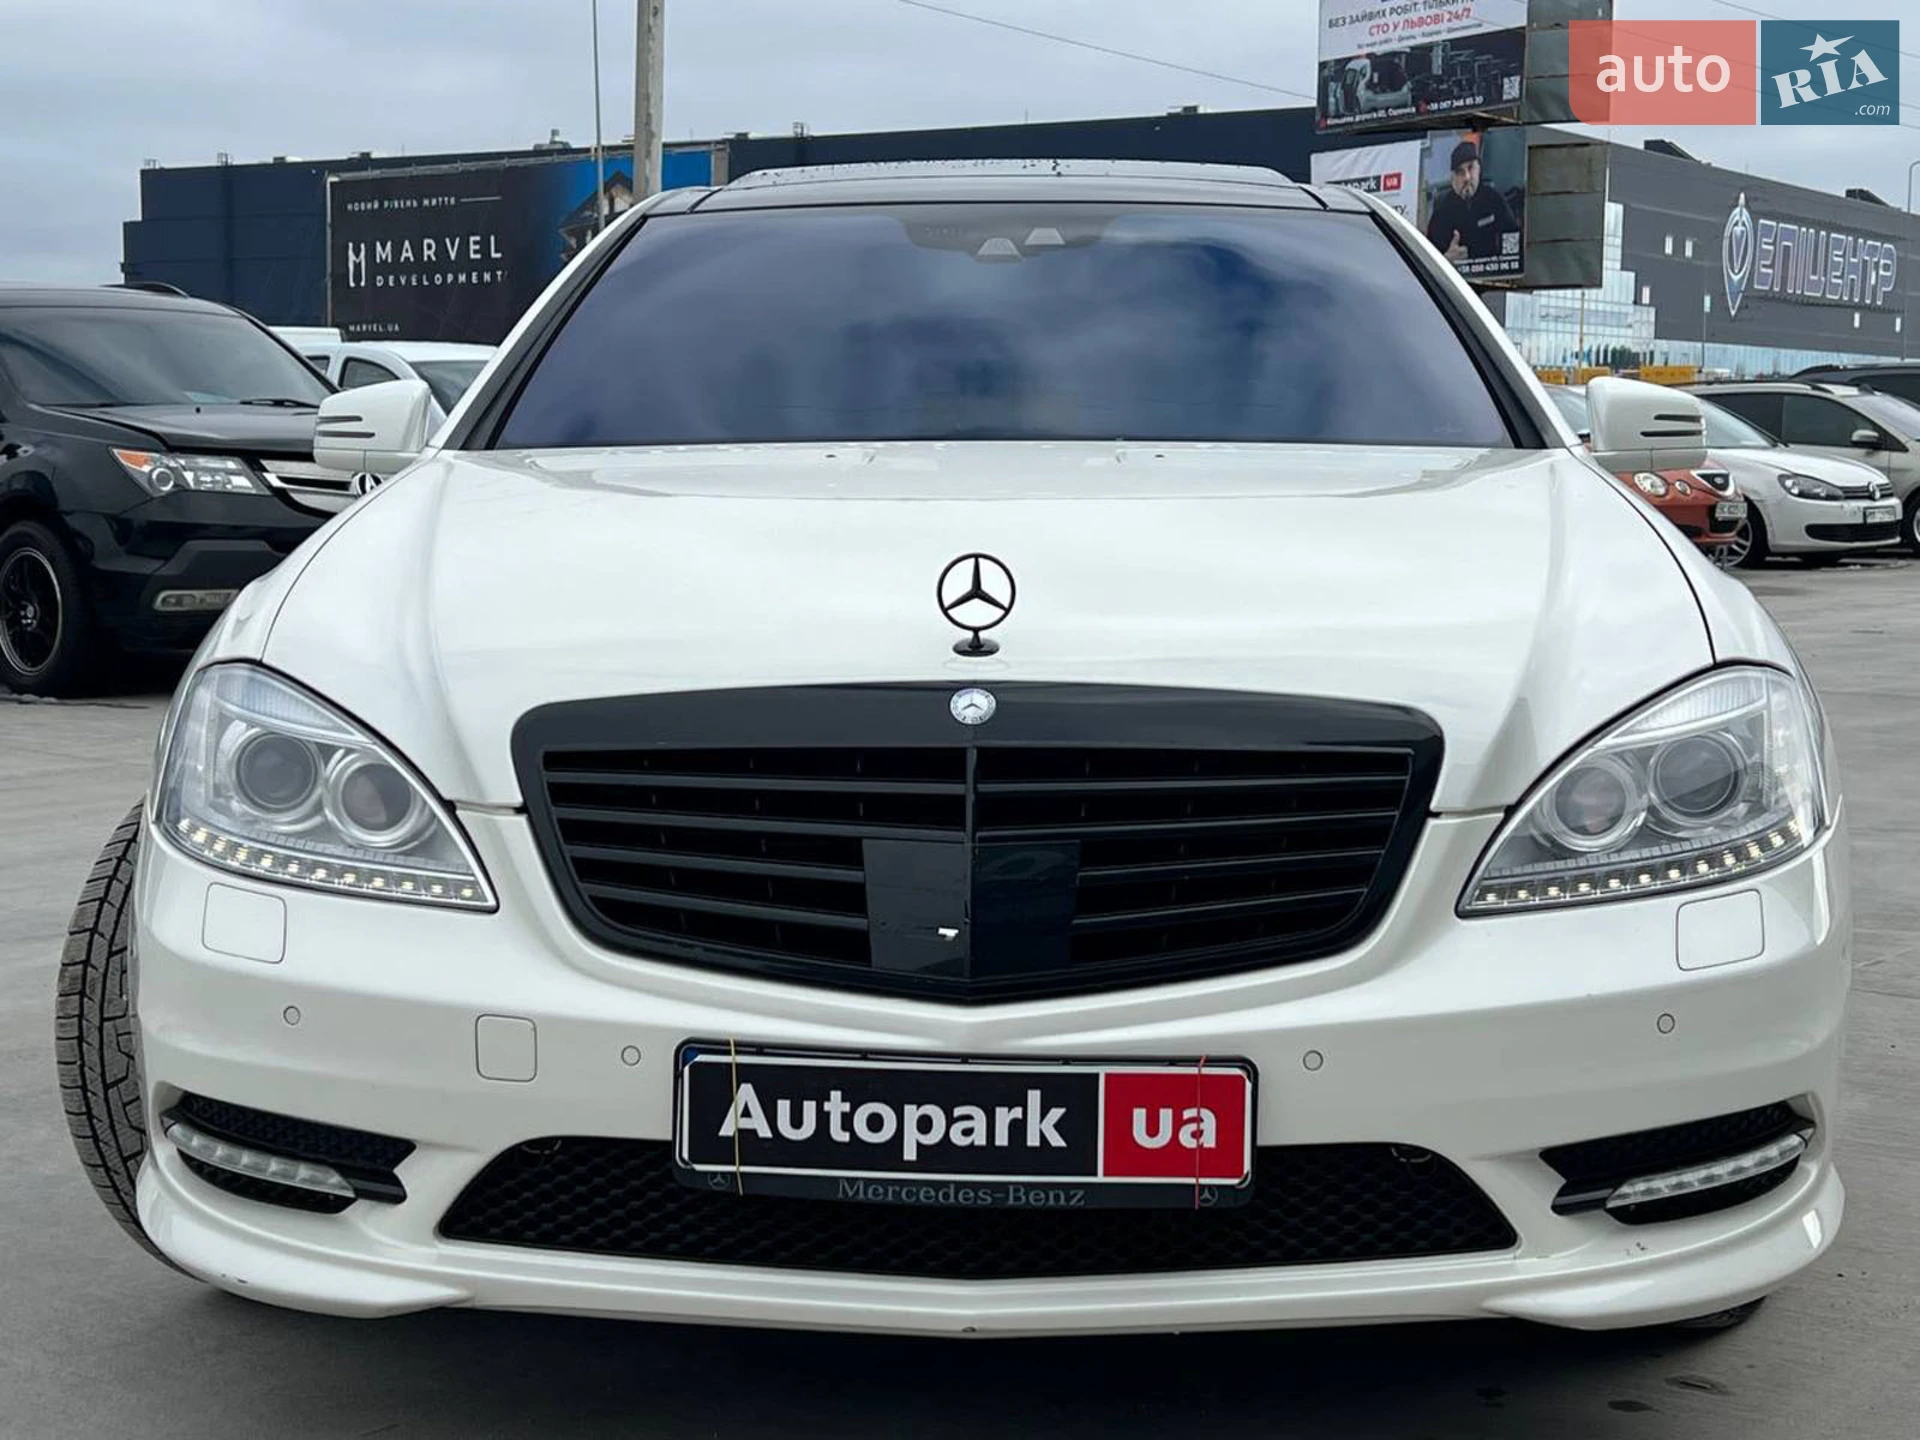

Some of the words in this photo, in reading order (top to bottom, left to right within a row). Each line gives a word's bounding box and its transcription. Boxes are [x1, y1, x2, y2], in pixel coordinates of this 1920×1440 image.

[1328, 15, 1346, 29] БЕЗ
[1348, 8, 1387, 25] ЗАЙВИХ
[1368, 23, 1390, 36] СТО
[1391, 20, 1401, 33] У
[1401, 13, 1444, 31] ЛЬВОВІ
[1446, 7, 1472, 24] 24/7
[376, 235, 502, 263] MARVEL
[1754, 219, 1896, 305] ЕПІЦЕНТР
[376, 271, 503, 287] DEVELOPMENT
[718, 1082, 1068, 1162] Autopark
[1132, 1105, 1217, 1149] ua
[838, 1179, 1086, 1207] Mercedes-Benz
